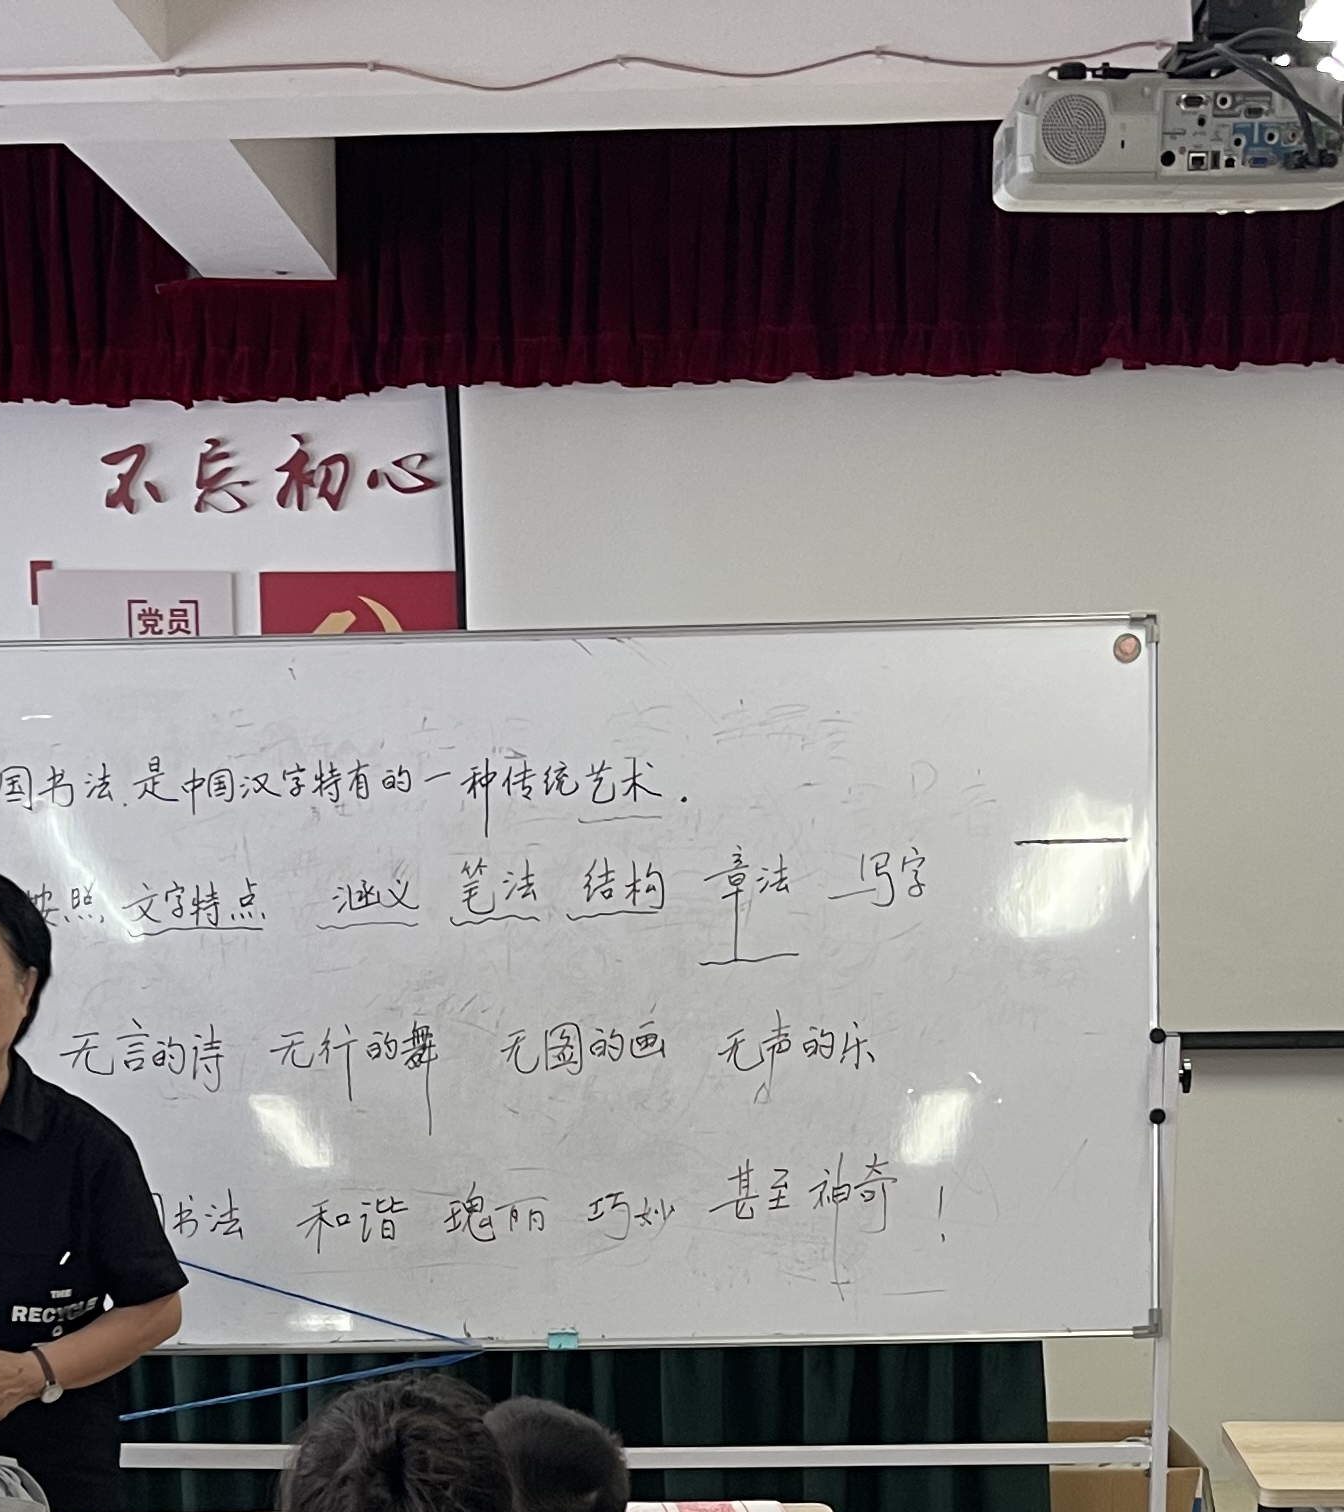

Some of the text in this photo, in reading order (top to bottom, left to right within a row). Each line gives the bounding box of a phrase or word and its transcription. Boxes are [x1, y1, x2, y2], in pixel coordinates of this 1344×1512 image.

[100, 433, 438, 514] 不忘初心
[137, 606, 192, 637] 党员
[459, 858, 538, 916] 笔法
[582, 859, 665, 911] 结构
[59, 1018, 225, 1093] 无言的诗
[151, 1187, 244, 1241] 书法
[296, 1194, 409, 1254] 和谐
[586, 1190, 676, 1241] 巧妙
[11, 1296, 99, 1323] RECYCLE
